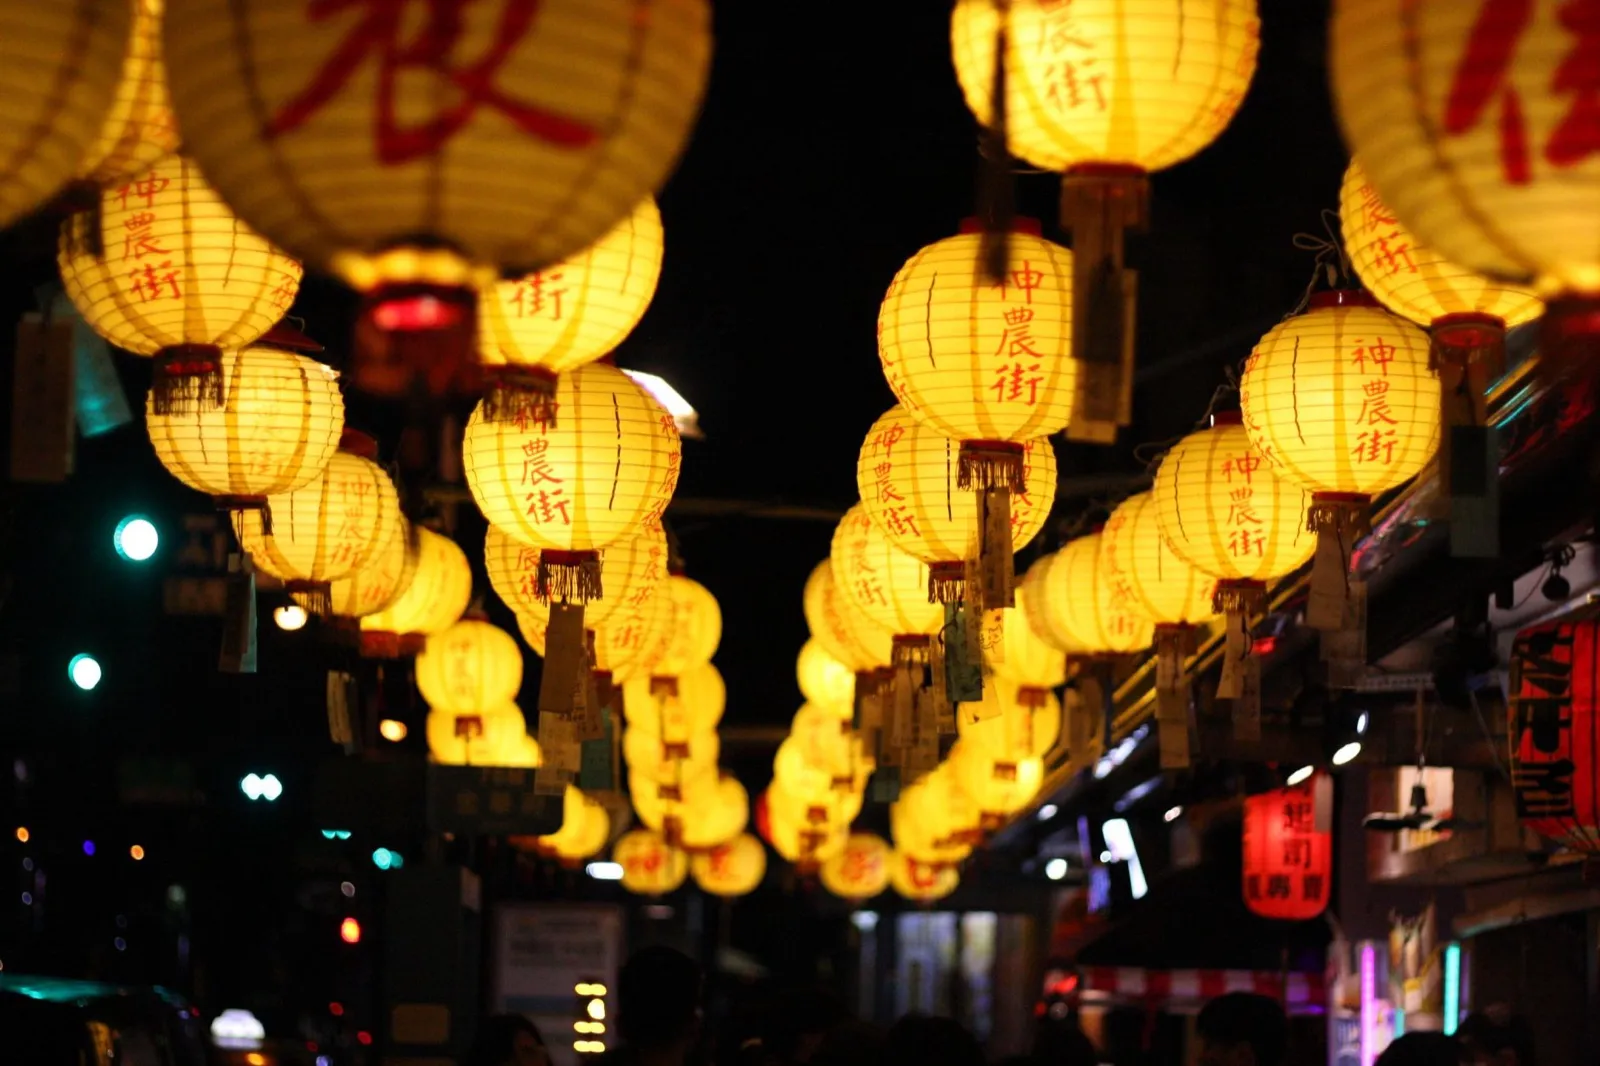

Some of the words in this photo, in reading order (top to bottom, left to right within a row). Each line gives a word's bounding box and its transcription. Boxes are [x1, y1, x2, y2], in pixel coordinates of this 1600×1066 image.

[111, 171, 184, 304] 神農街
[989, 259, 1045, 406] 神農街
[1350, 336, 1402, 466] 神農街
[870, 421, 922, 538] 神農街
[1220, 449, 1268, 559] 神農街
